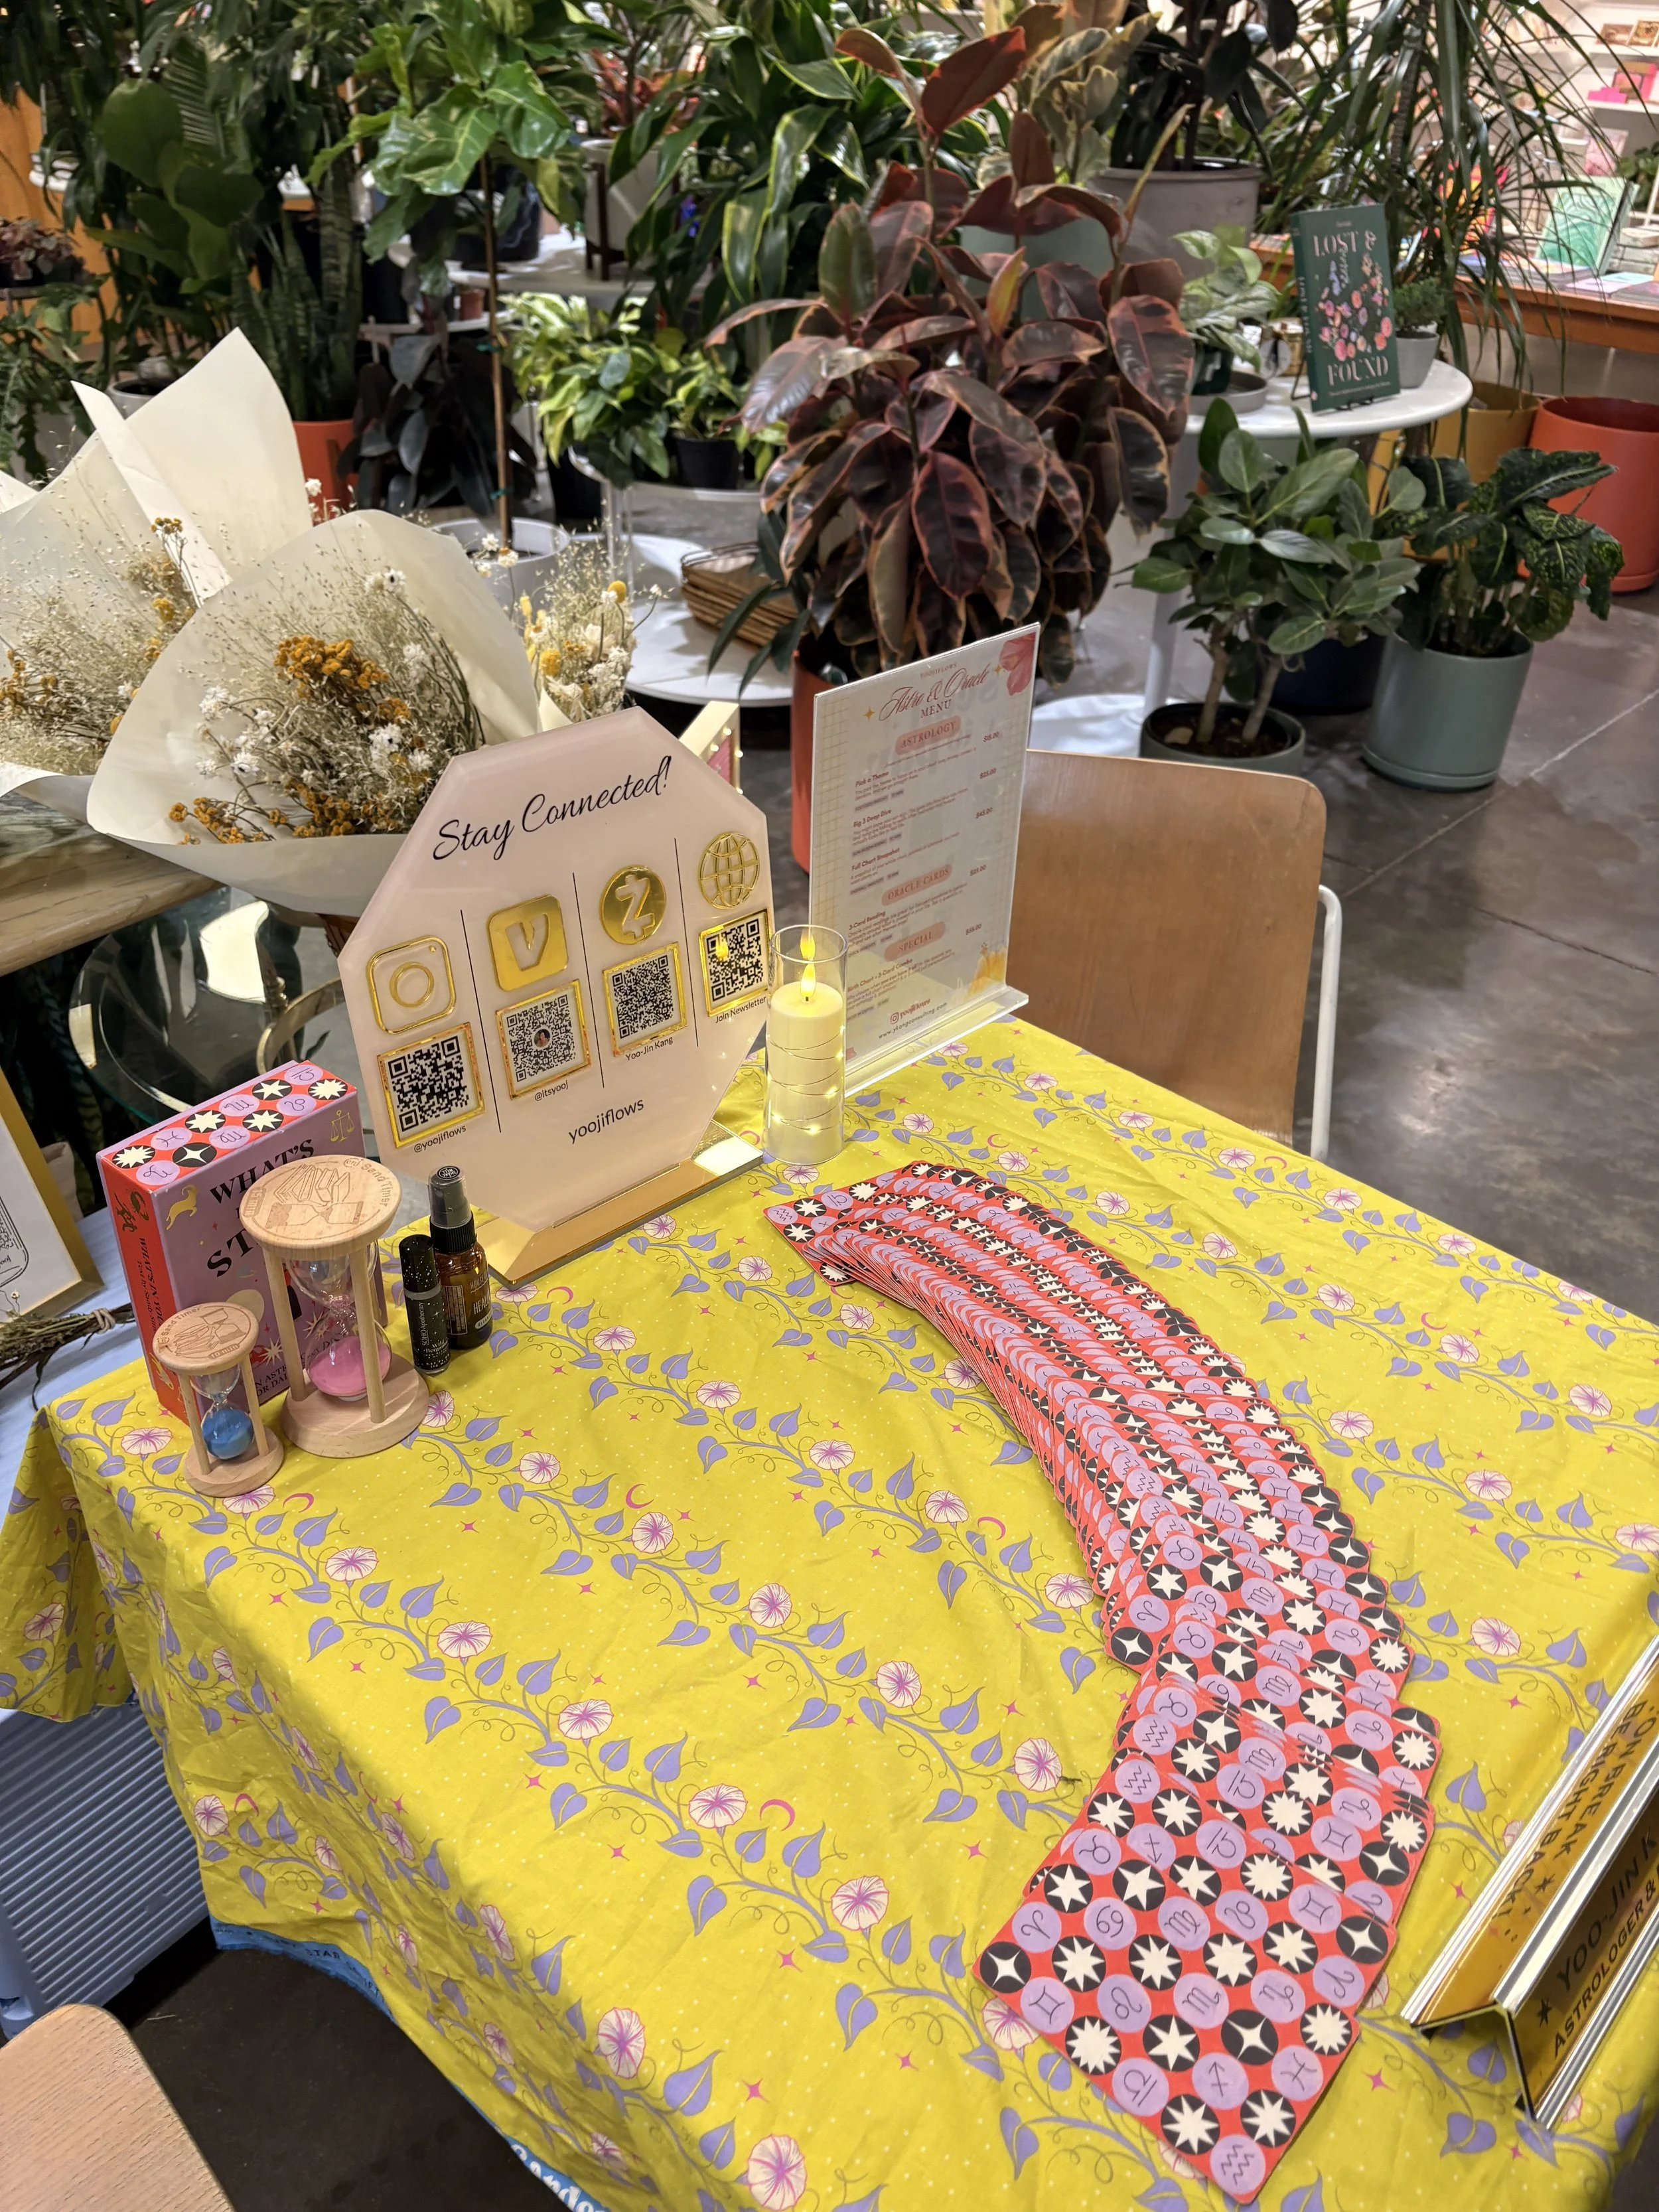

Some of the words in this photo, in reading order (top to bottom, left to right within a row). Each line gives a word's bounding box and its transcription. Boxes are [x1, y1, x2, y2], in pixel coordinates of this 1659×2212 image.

[1313, 230, 1358, 258] LOST
[1327, 356, 1389, 386] FOUND
[879, 686, 924, 721] Astro
[944, 662, 991, 698] Oracle
[920, 699, 952, 718] MENU
[900, 720, 956, 749] ASTROLOGY
[432, 818, 514, 861] Stay
[521, 755, 673, 833] Connected!
[887, 880, 920, 901] ORACLE
[923, 868, 950, 886] CARDS
[899, 931, 933, 952] SPECIAL
[715, 1010, 731, 1024] Join
[732, 995, 768, 1021] Newsletter
[625, 1041, 652, 1062] Yoo-Jin
[653, 1036, 674, 1055] Kang
[534, 1080, 569, 1102] @itsyooj
[567, 1097, 646, 1145] yoojiflows
[413, 1124, 468, 1153] @yoojiflows
[361, 1163, 387, 1182] Sand
[380, 1181, 394, 1207] Timer
[161, 1319, 177, 1337] Sand
[175, 1306, 202, 1321] Timer
[1611, 1700, 1648, 1740] BE
[1558, 1741, 1618, 1821] RIGHT
[1552, 1763, 1626, 1861] BREAK
[1492, 1828, 1563, 1920] BACK!
[1557, 1856, 1640, 1992] YOO-JIN
[1554, 1899, 1644, 2059] ASTROLOGER
